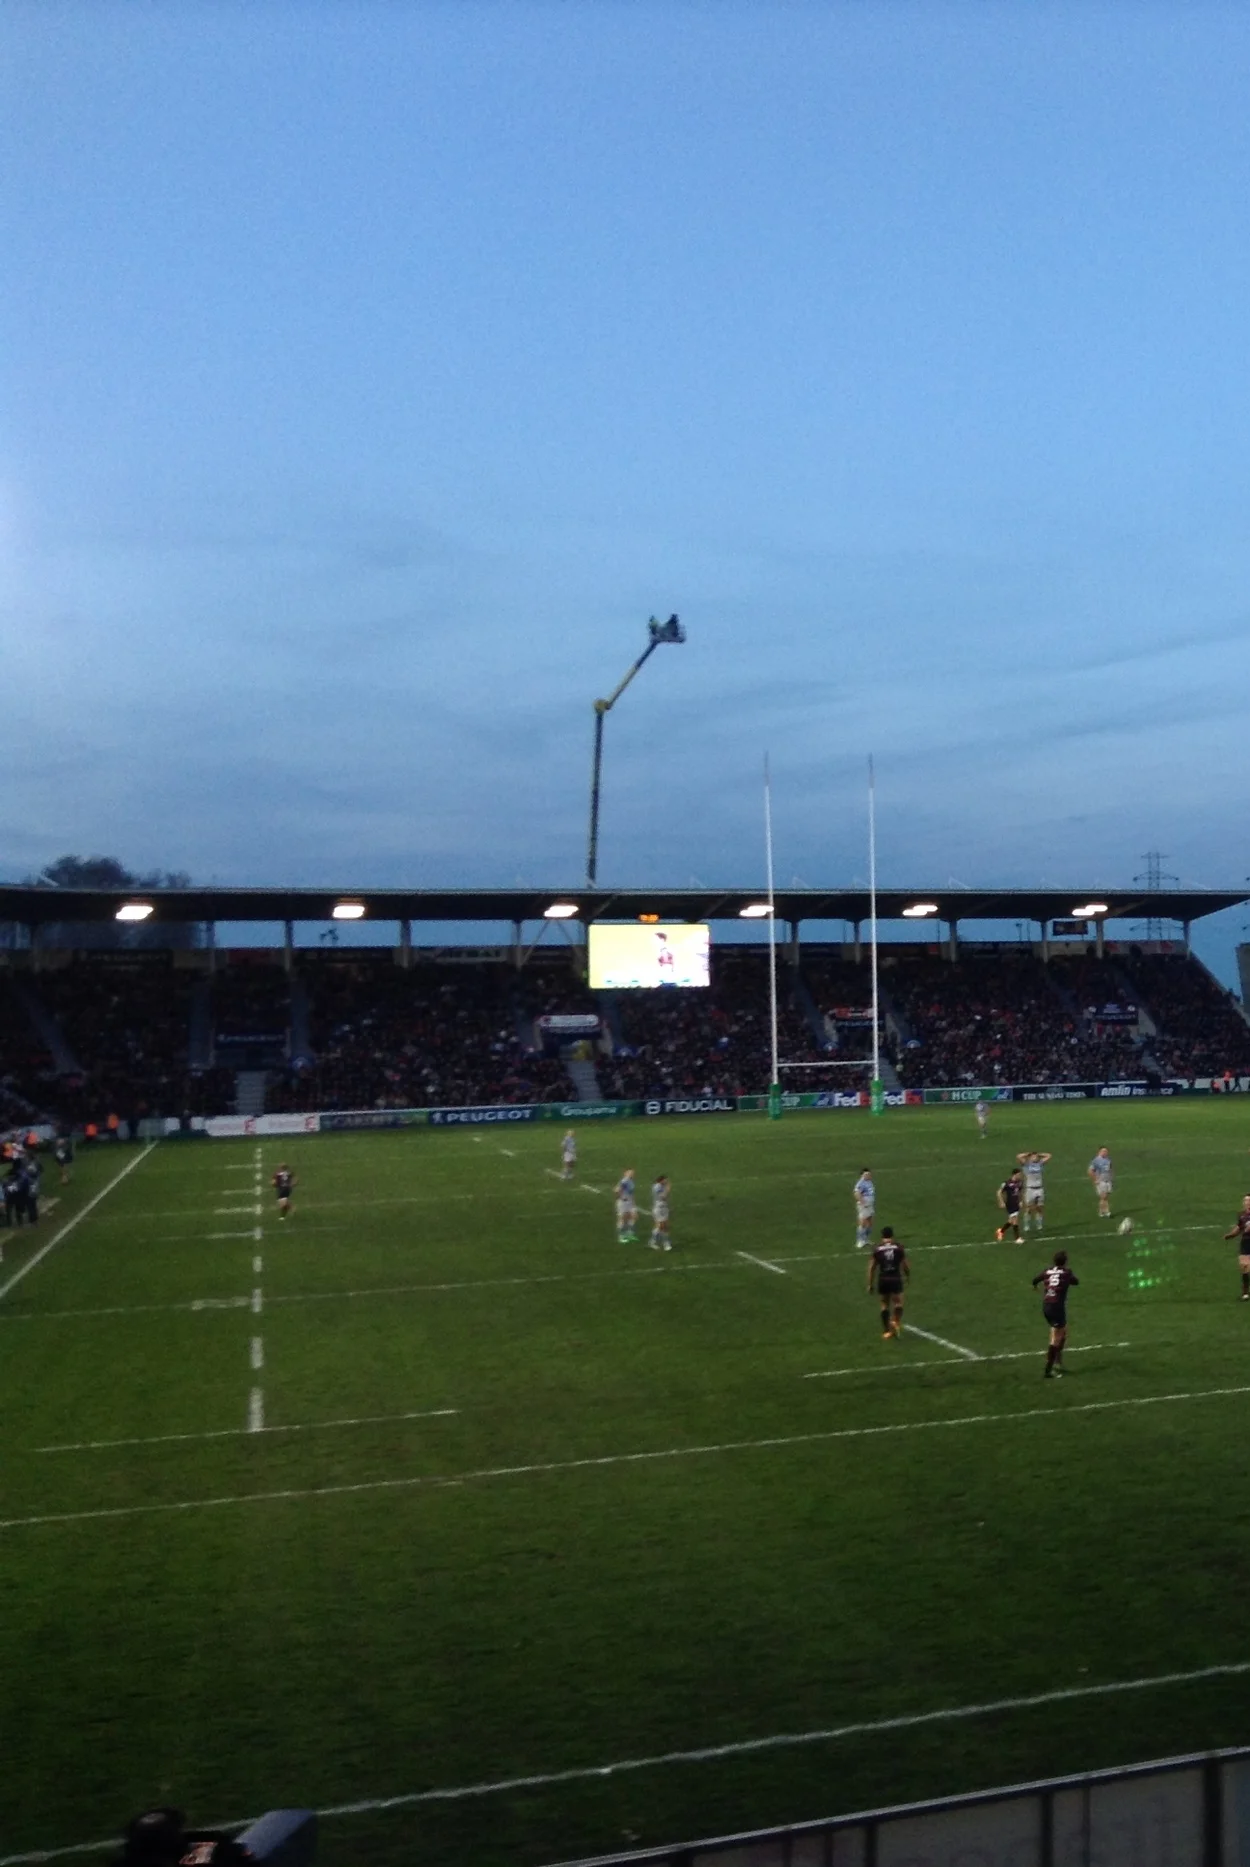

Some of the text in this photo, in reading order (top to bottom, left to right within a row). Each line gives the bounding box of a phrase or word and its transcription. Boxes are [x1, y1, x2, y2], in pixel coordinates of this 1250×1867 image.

[961, 1090, 982, 1100] CUP
[665, 1100, 734, 1113] FIDUCIAL
[446, 1109, 533, 1122] PEUGEOT
